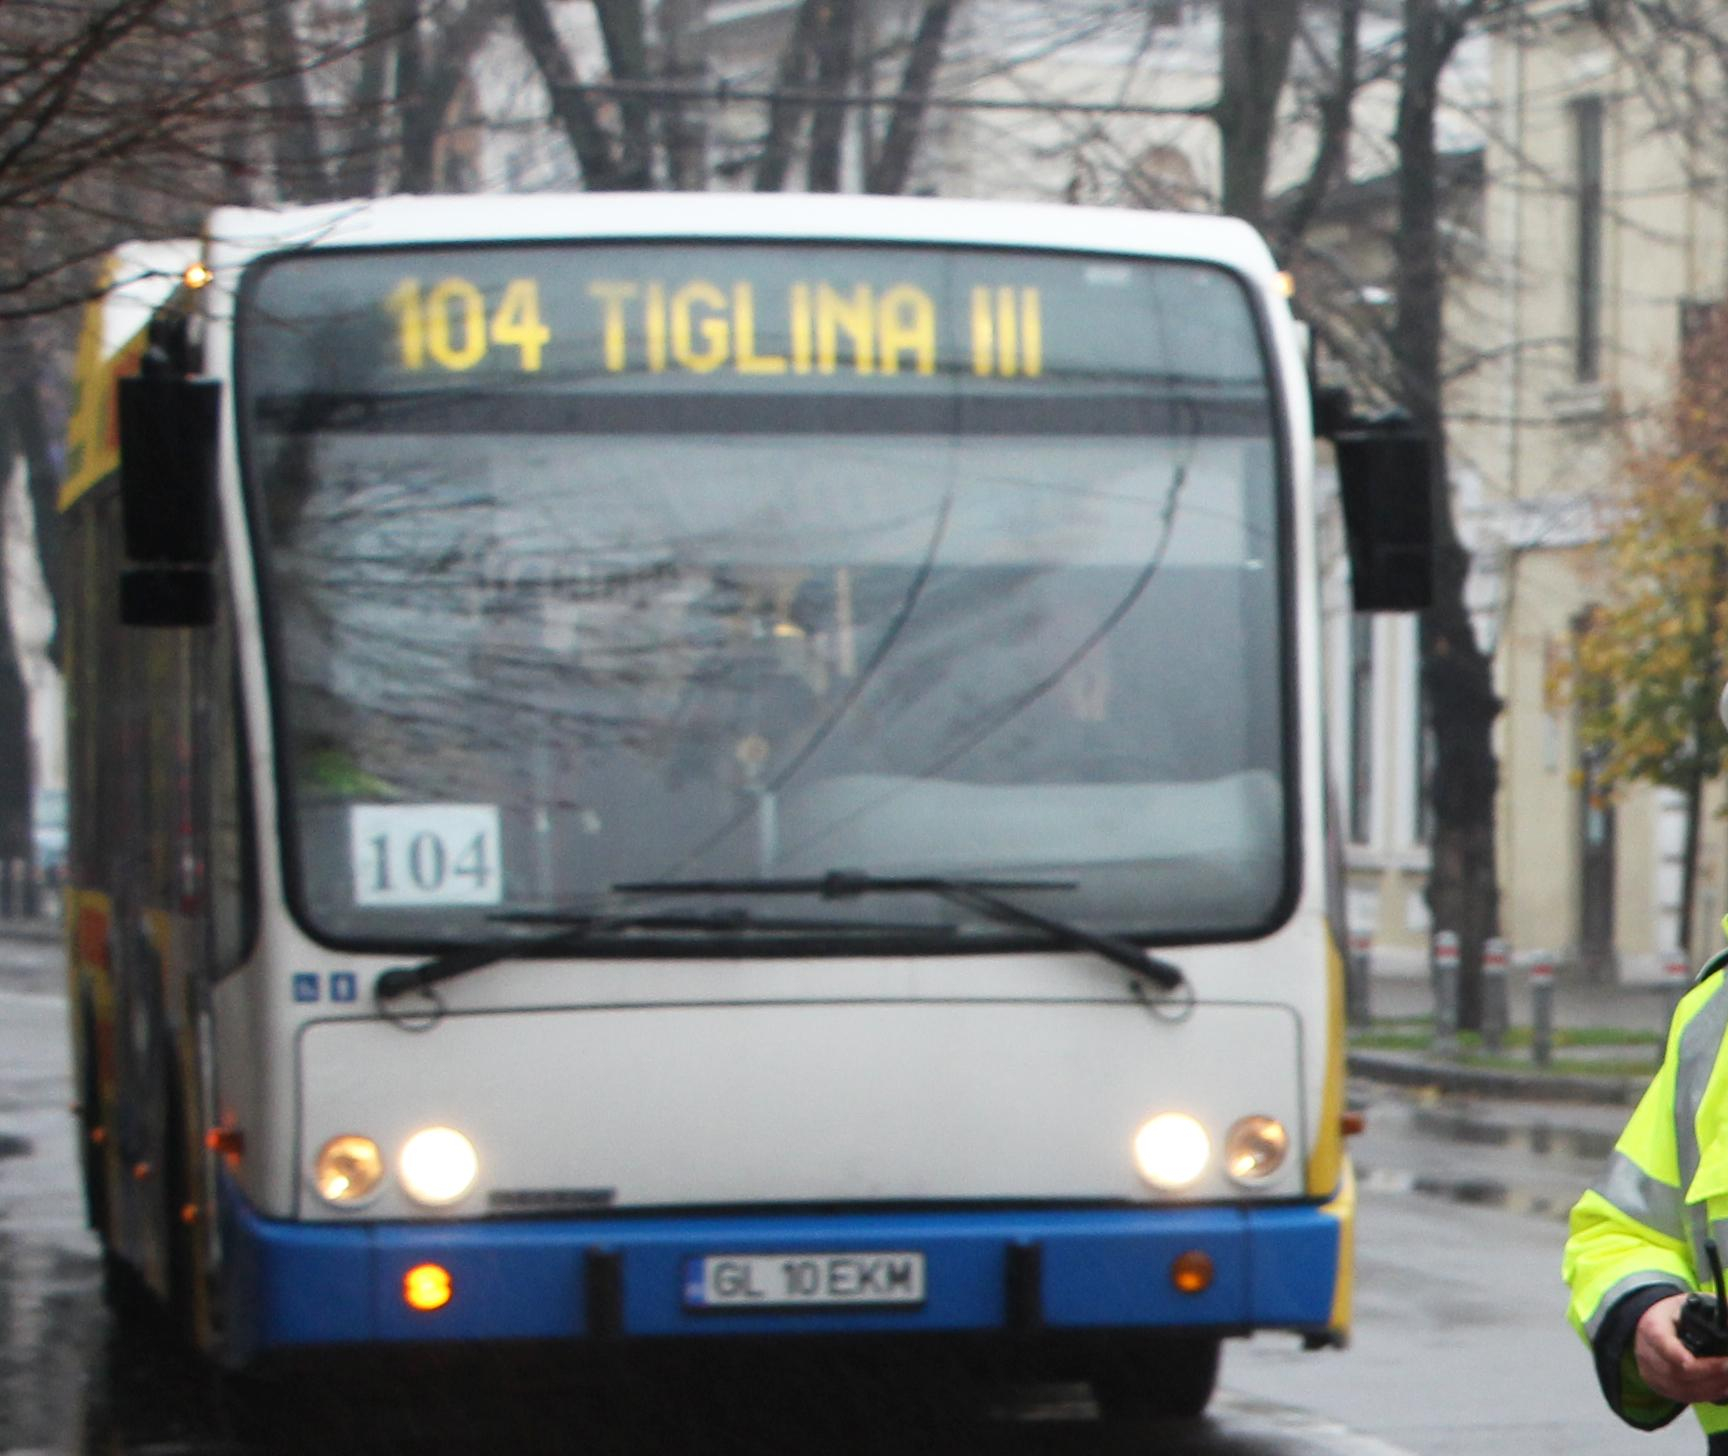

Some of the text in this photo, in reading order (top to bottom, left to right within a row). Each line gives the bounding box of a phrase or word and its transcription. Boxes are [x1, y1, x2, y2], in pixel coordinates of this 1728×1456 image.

[385, 278, 1042, 378] 104 TIGLINA III
[367, 831, 491, 891] 104
[713, 1261, 764, 1298] GL
[783, 1260, 820, 1295] 10
